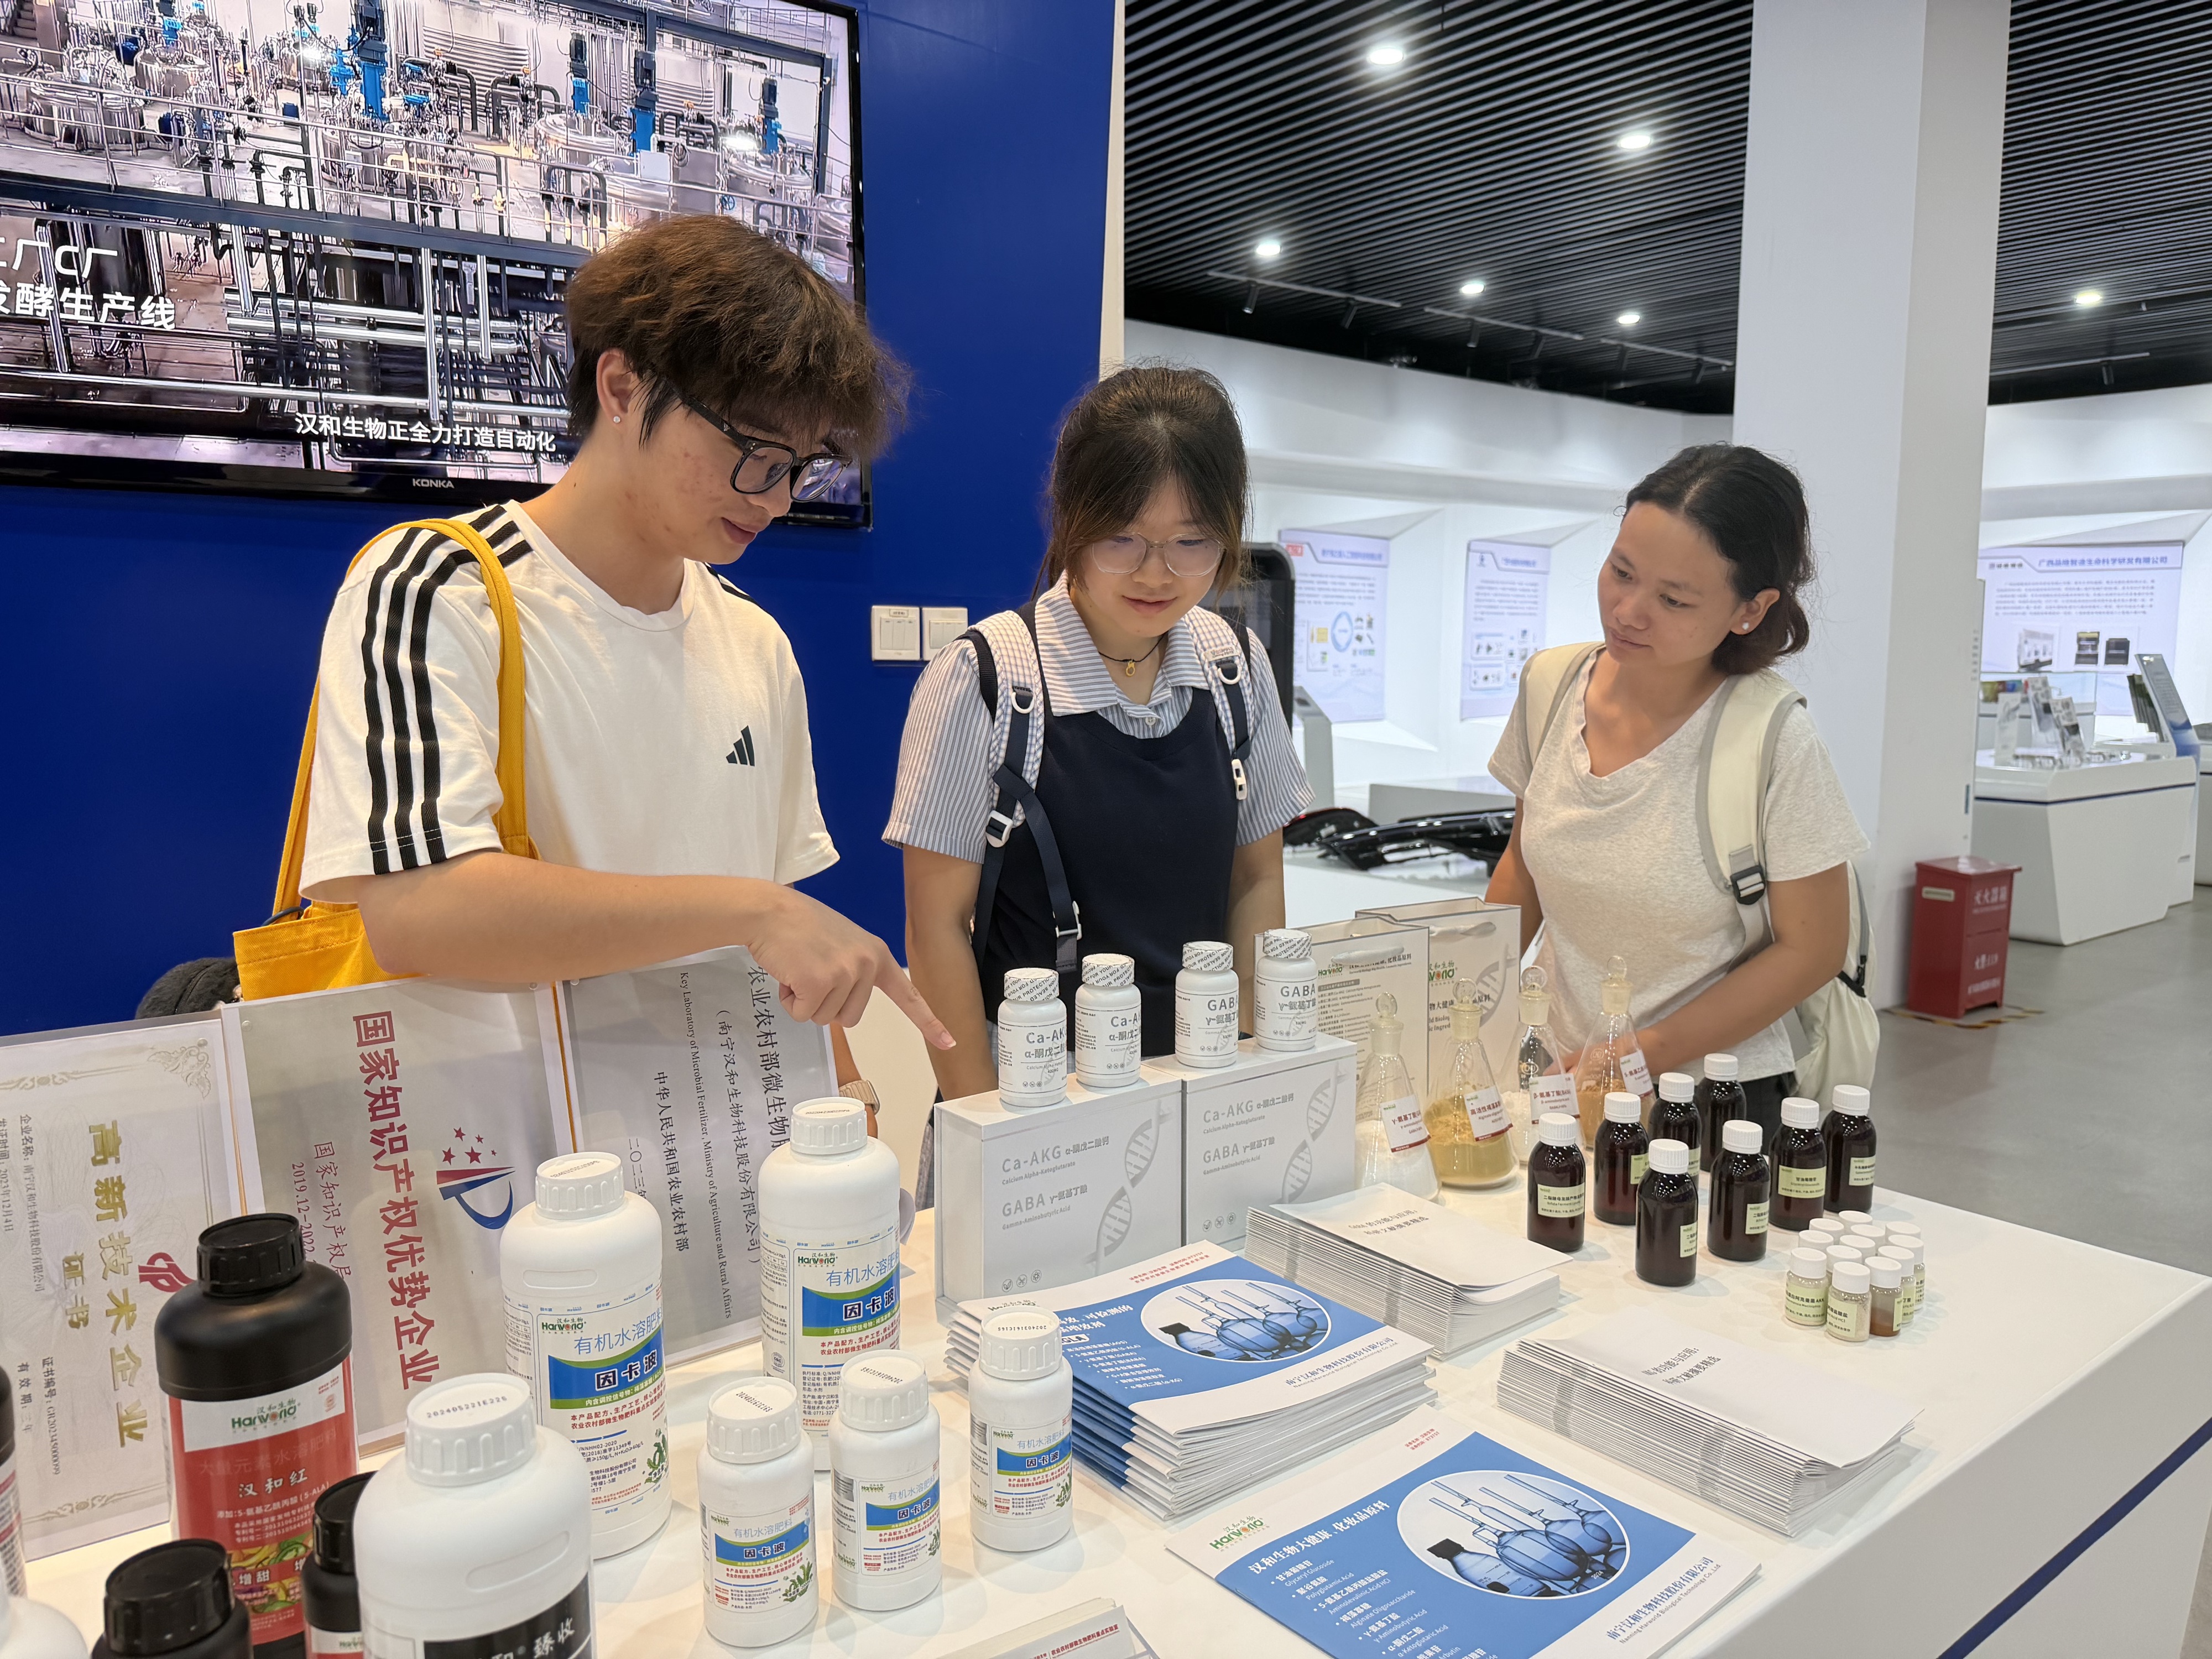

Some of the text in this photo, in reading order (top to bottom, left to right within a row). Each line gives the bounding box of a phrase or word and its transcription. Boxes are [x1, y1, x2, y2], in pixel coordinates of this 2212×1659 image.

[295, 412, 556, 452] 汉和生物正全力打造自动化
[413, 478, 455, 489] KONKA
[680, 972, 688, 989] Key
[1280, 983, 1316, 998] GABA
[683, 991, 695, 1039] Laboratory
[1110, 1013, 1141, 1027] Ca-A
[690, 1040, 698, 1050] of
[1026, 1028, 1067, 1044] Ca-AK
[691, 1051, 705, 1094] Microbial
[1203, 1099, 1254, 1123] Ca-AKG
[654, 1072, 690, 1252] 中华人民共和国农业农村部
[703, 1140, 714, 1178] Ministry
[1001, 1145, 1062, 1173] Ca-AKG
[1203, 1142, 1239, 1164] GABA
[708, 1180, 717, 1190] of
[1001, 1176, 1024, 1186] Calcium
[292, 1162, 316, 1264] 2019.12-2022
[314, 1141, 351, 1279] 国家知识产权局
[353, 1011, 440, 1390] 国家知识产权优势企业
[1001, 1193, 1046, 1217] GABA
[1059, 1205, 1071, 1214] Acid
[709, 1191, 723, 1242] Agriculture
[717, 1244, 725, 1260] and
[797, 1256, 836, 1264] Harworld
[88, 1119, 147, 1448] 高新技术企业
[719, 1260, 730, 1288] Rural
[62, 1251, 90, 1329] 证书
[722, 1287, 733, 1319] Affairs
[843, 1286, 895, 1321] 因卡波
[541, 1322, 584, 1331] Harworld
[1061, 1335, 1087, 1344] GLA
[596, 1349, 658, 1391] 因卡波
[1285, 1337, 1394, 1386] 南宁汉和生物科技股份有限公司
[1335, 1360, 1357, 1373] Biological
[1358, 1350, 1382, 1362] Technology
[231, 1405, 297, 1430] Harworld
[577, 1440, 617, 1451] /NNHH02-2020
[1026, 1451, 1060, 1469] 因卡波
[238, 1468, 308, 1499] 汉和红
[898, 1498, 931, 1521] 因卡波
[734, 1519, 793, 1538] 有机水溶肥料
[1209, 1518, 1265, 1550] Harworld
[1223, 1515, 1256, 1533] 汉和生物
[1248, 1500, 1391, 1574] 汉和生物大健康、化妆品原料
[744, 1542, 785, 1559] 因卡波
[239, 1568, 270, 1585] 增甜
[1284, 1558, 1335, 1588] Glyceryl Glucoside
[1295, 1575, 1328, 1596] 聚谷氨酸
[1305, 1572, 1354, 1601] Polyglutamic Acid
[1328, 1589, 1370, 1615] Aminolevulinic
[1369, 1582, 1381, 1592] Acid
[1606, 1556, 1714, 1640] 南宁汉和生物科技股份有限公司
[1350, 1589, 1416, 1629] Alginate Oligosaccharide
[1414, 1609, 1427, 1619] Acid
[1619, 1627, 1642, 1644] Nanning
[1640, 1611, 1662, 1630] Harworld
[1658, 1595, 1683, 1614] Biological
[1682, 1578, 1707, 1598] Technology
[1363, 1612, 1401, 1638] γ-氨基丁酸
[1436, 1624, 1449, 1634] Acid
[1387, 1626, 1425, 1652] α-酮戊二酸
